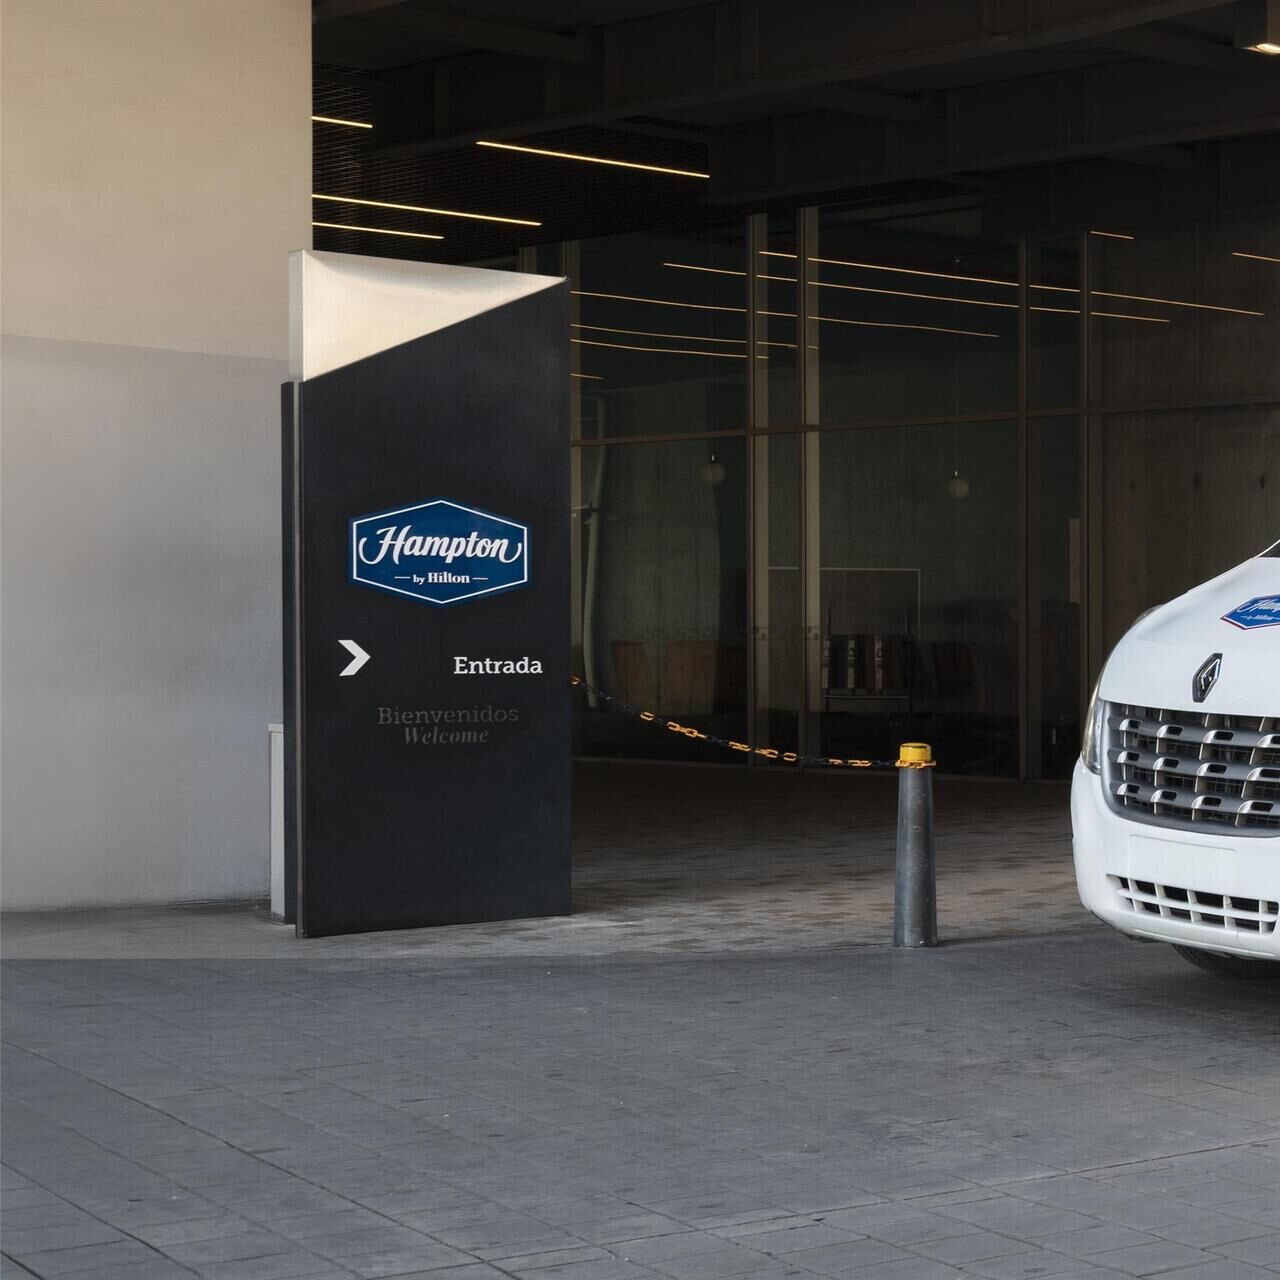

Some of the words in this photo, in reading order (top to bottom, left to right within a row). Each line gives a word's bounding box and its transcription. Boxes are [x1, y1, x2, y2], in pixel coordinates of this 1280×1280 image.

[358, 525, 522, 565] Hampton
[413, 574, 426, 585] by
[428, 572, 470, 584] Hilton
[453, 656, 543, 674] Entrada
[377, 705, 520, 725] Bienvenidos
[404, 726, 489, 744] Welcome
